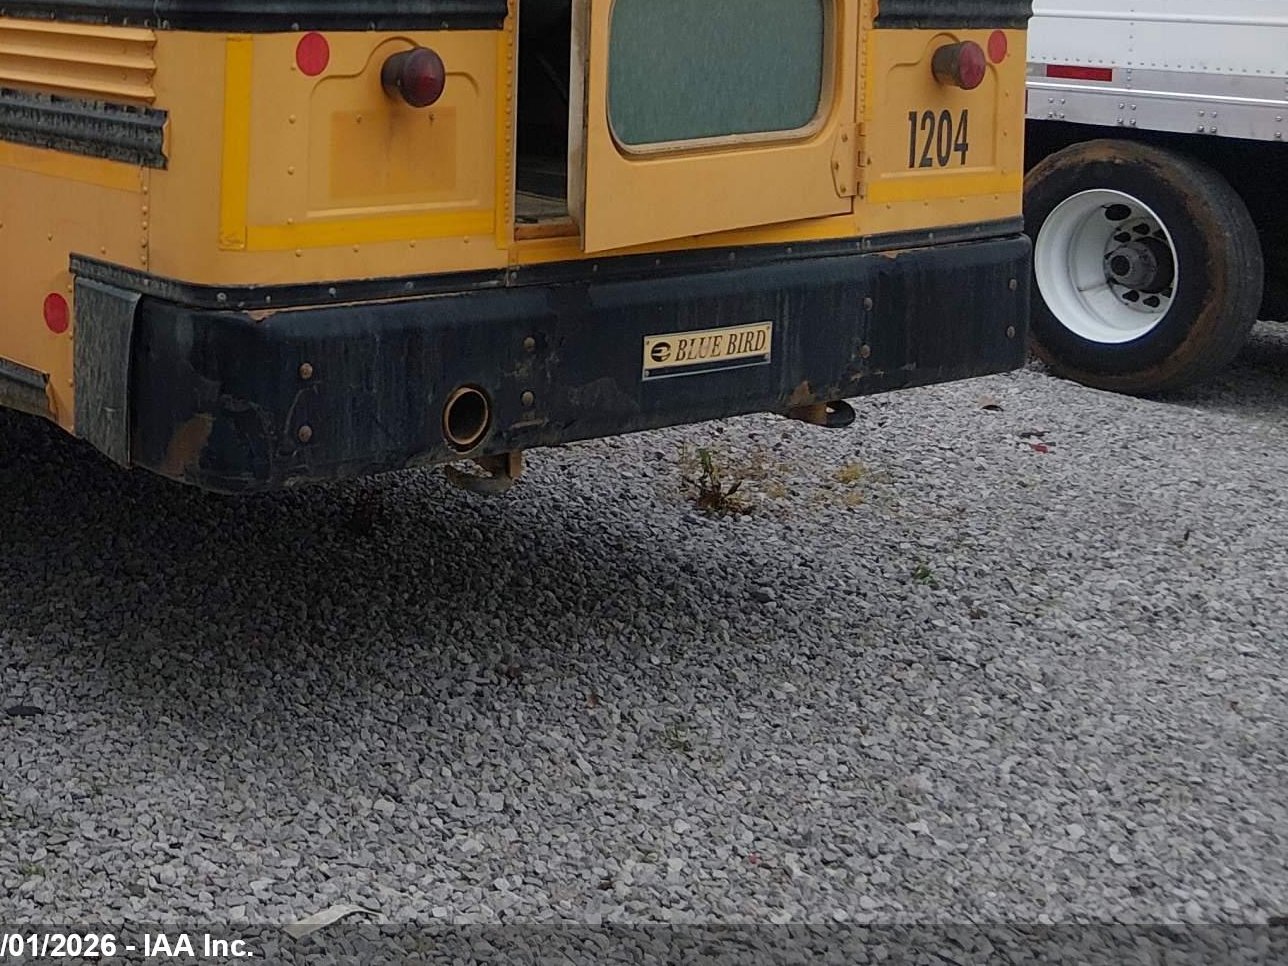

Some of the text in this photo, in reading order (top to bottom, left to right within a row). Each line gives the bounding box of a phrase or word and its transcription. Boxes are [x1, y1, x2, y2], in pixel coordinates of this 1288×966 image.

[908, 109, 969, 169] 1204
[675, 329, 766, 362] BLUE BIRD
